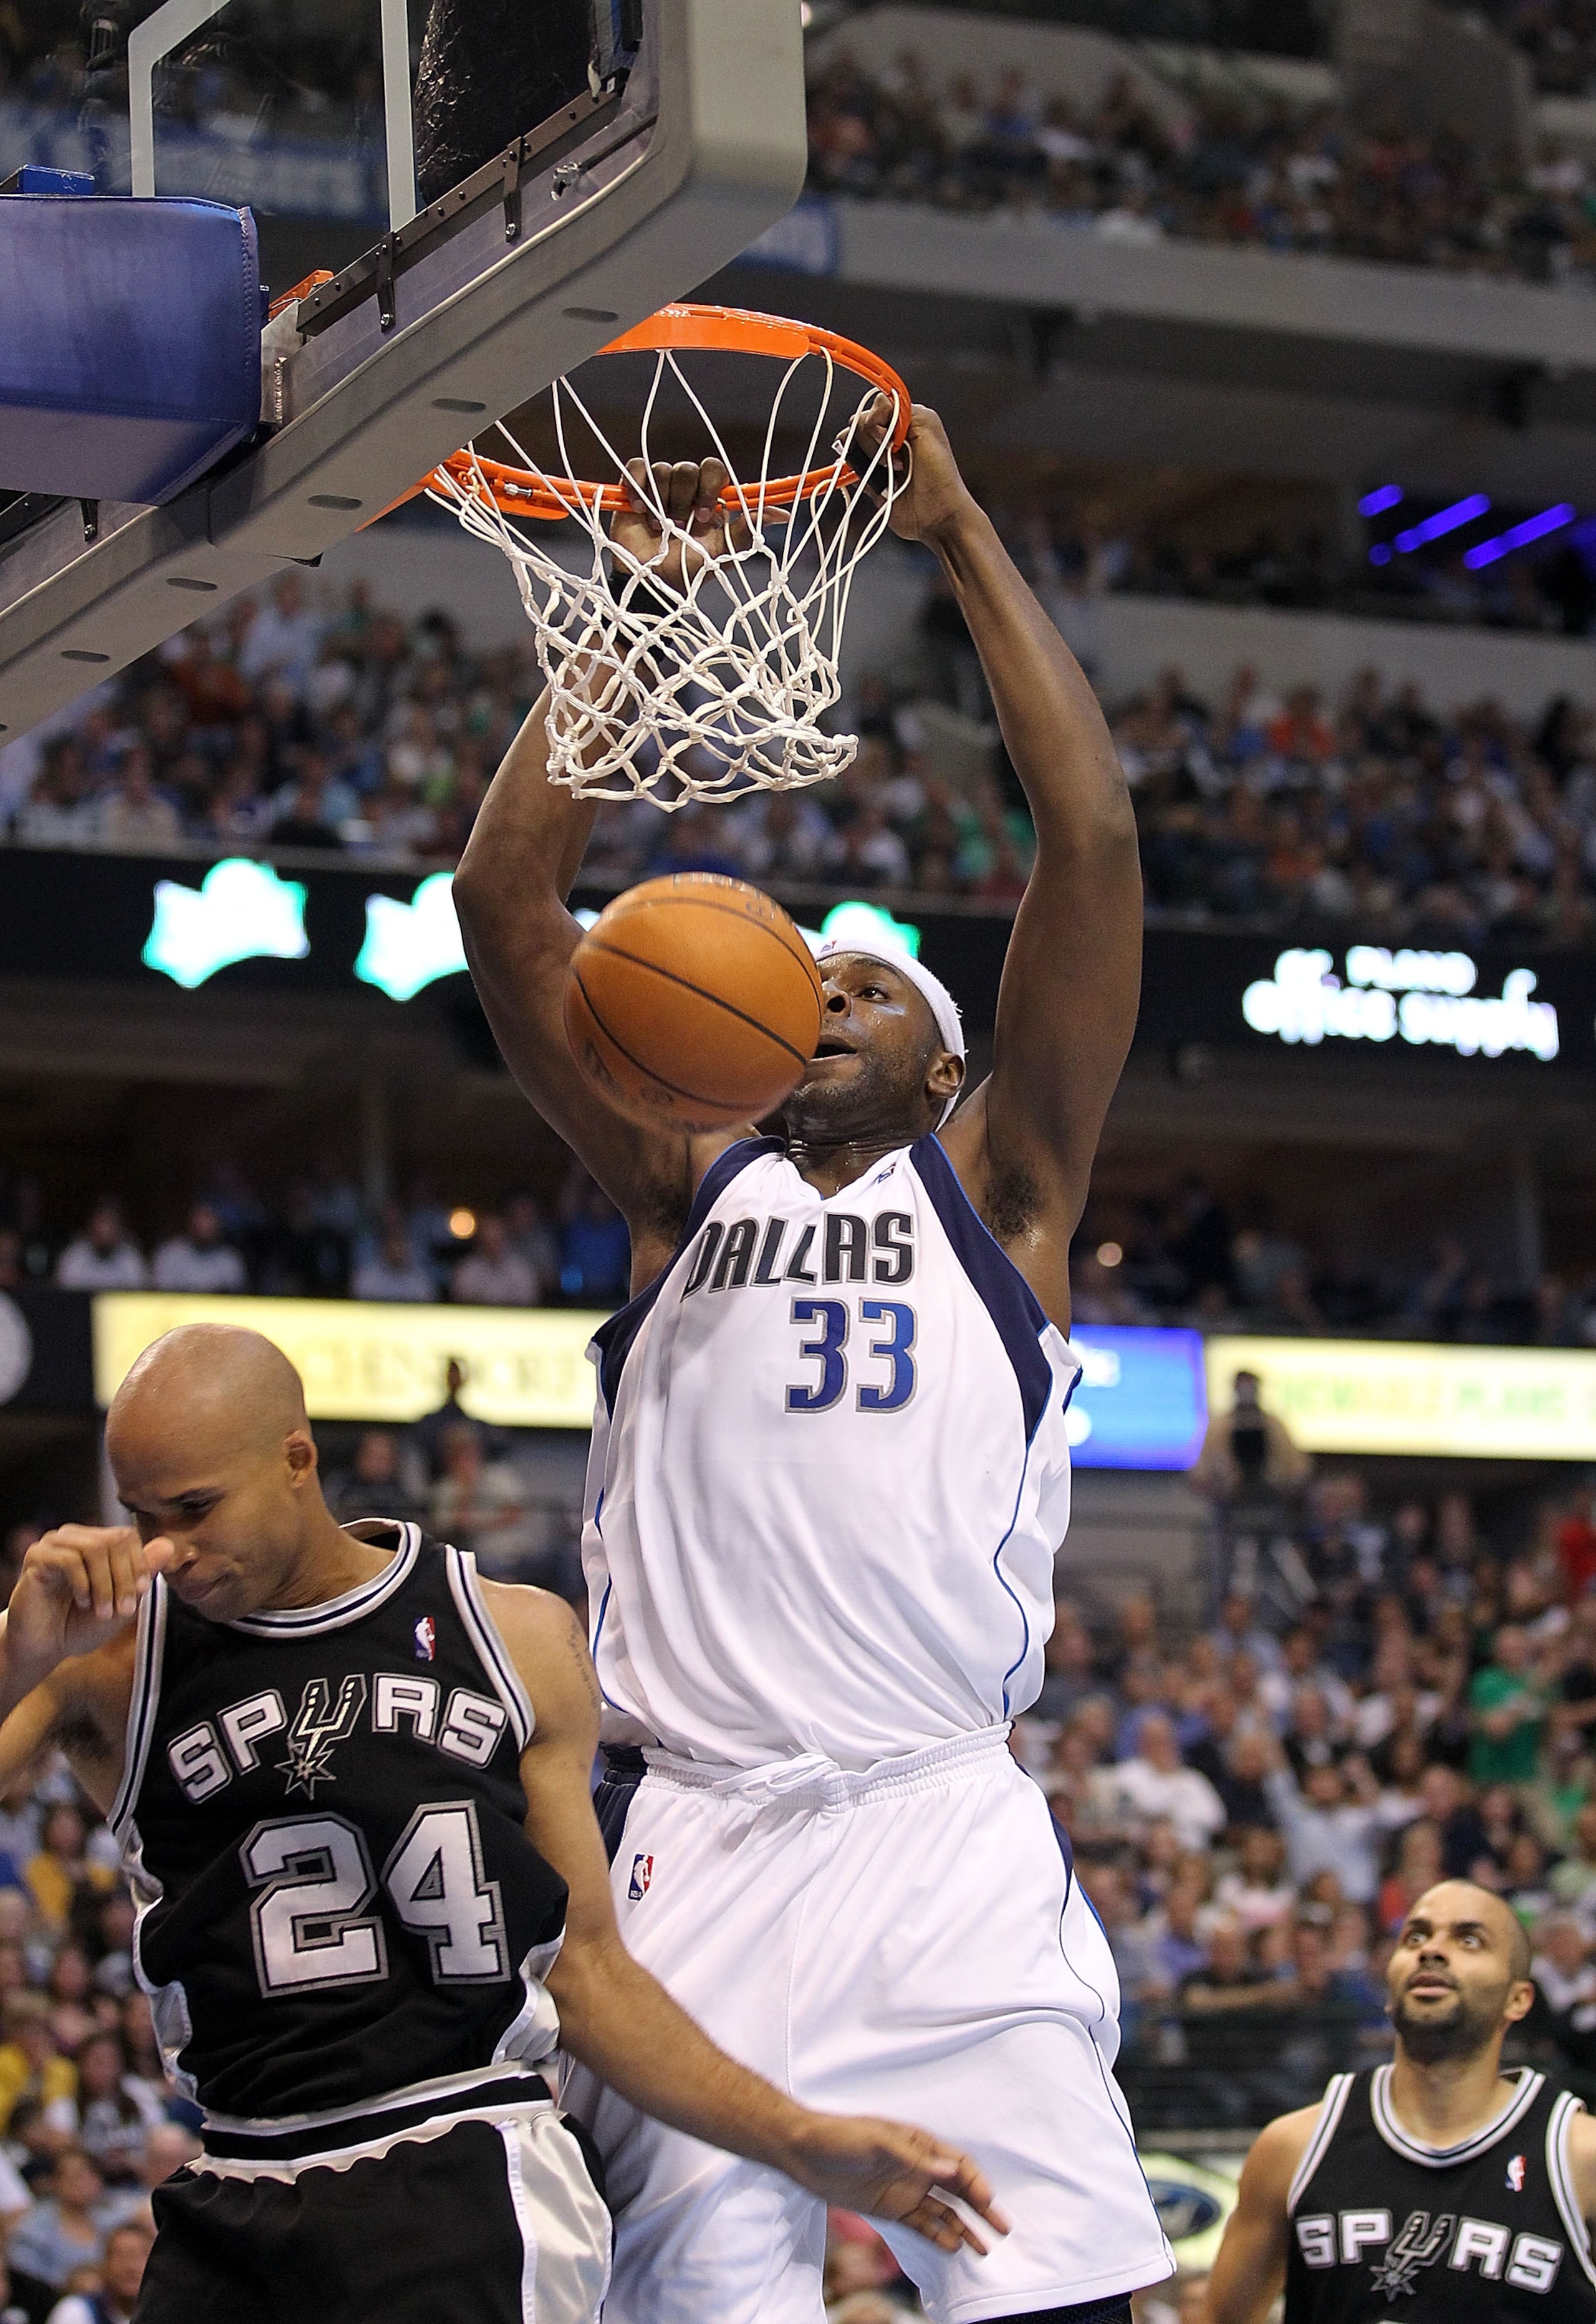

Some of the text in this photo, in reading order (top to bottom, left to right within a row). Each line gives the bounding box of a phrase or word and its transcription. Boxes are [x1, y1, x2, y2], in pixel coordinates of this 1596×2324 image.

[680, 1210, 915, 1302] DALLAS
[784, 1296, 919, 1414] 33
[166, 1673, 509, 1803] SPURS
[239, 1800, 512, 1997] 24
[1296, 2207, 1564, 2300] SPURS
